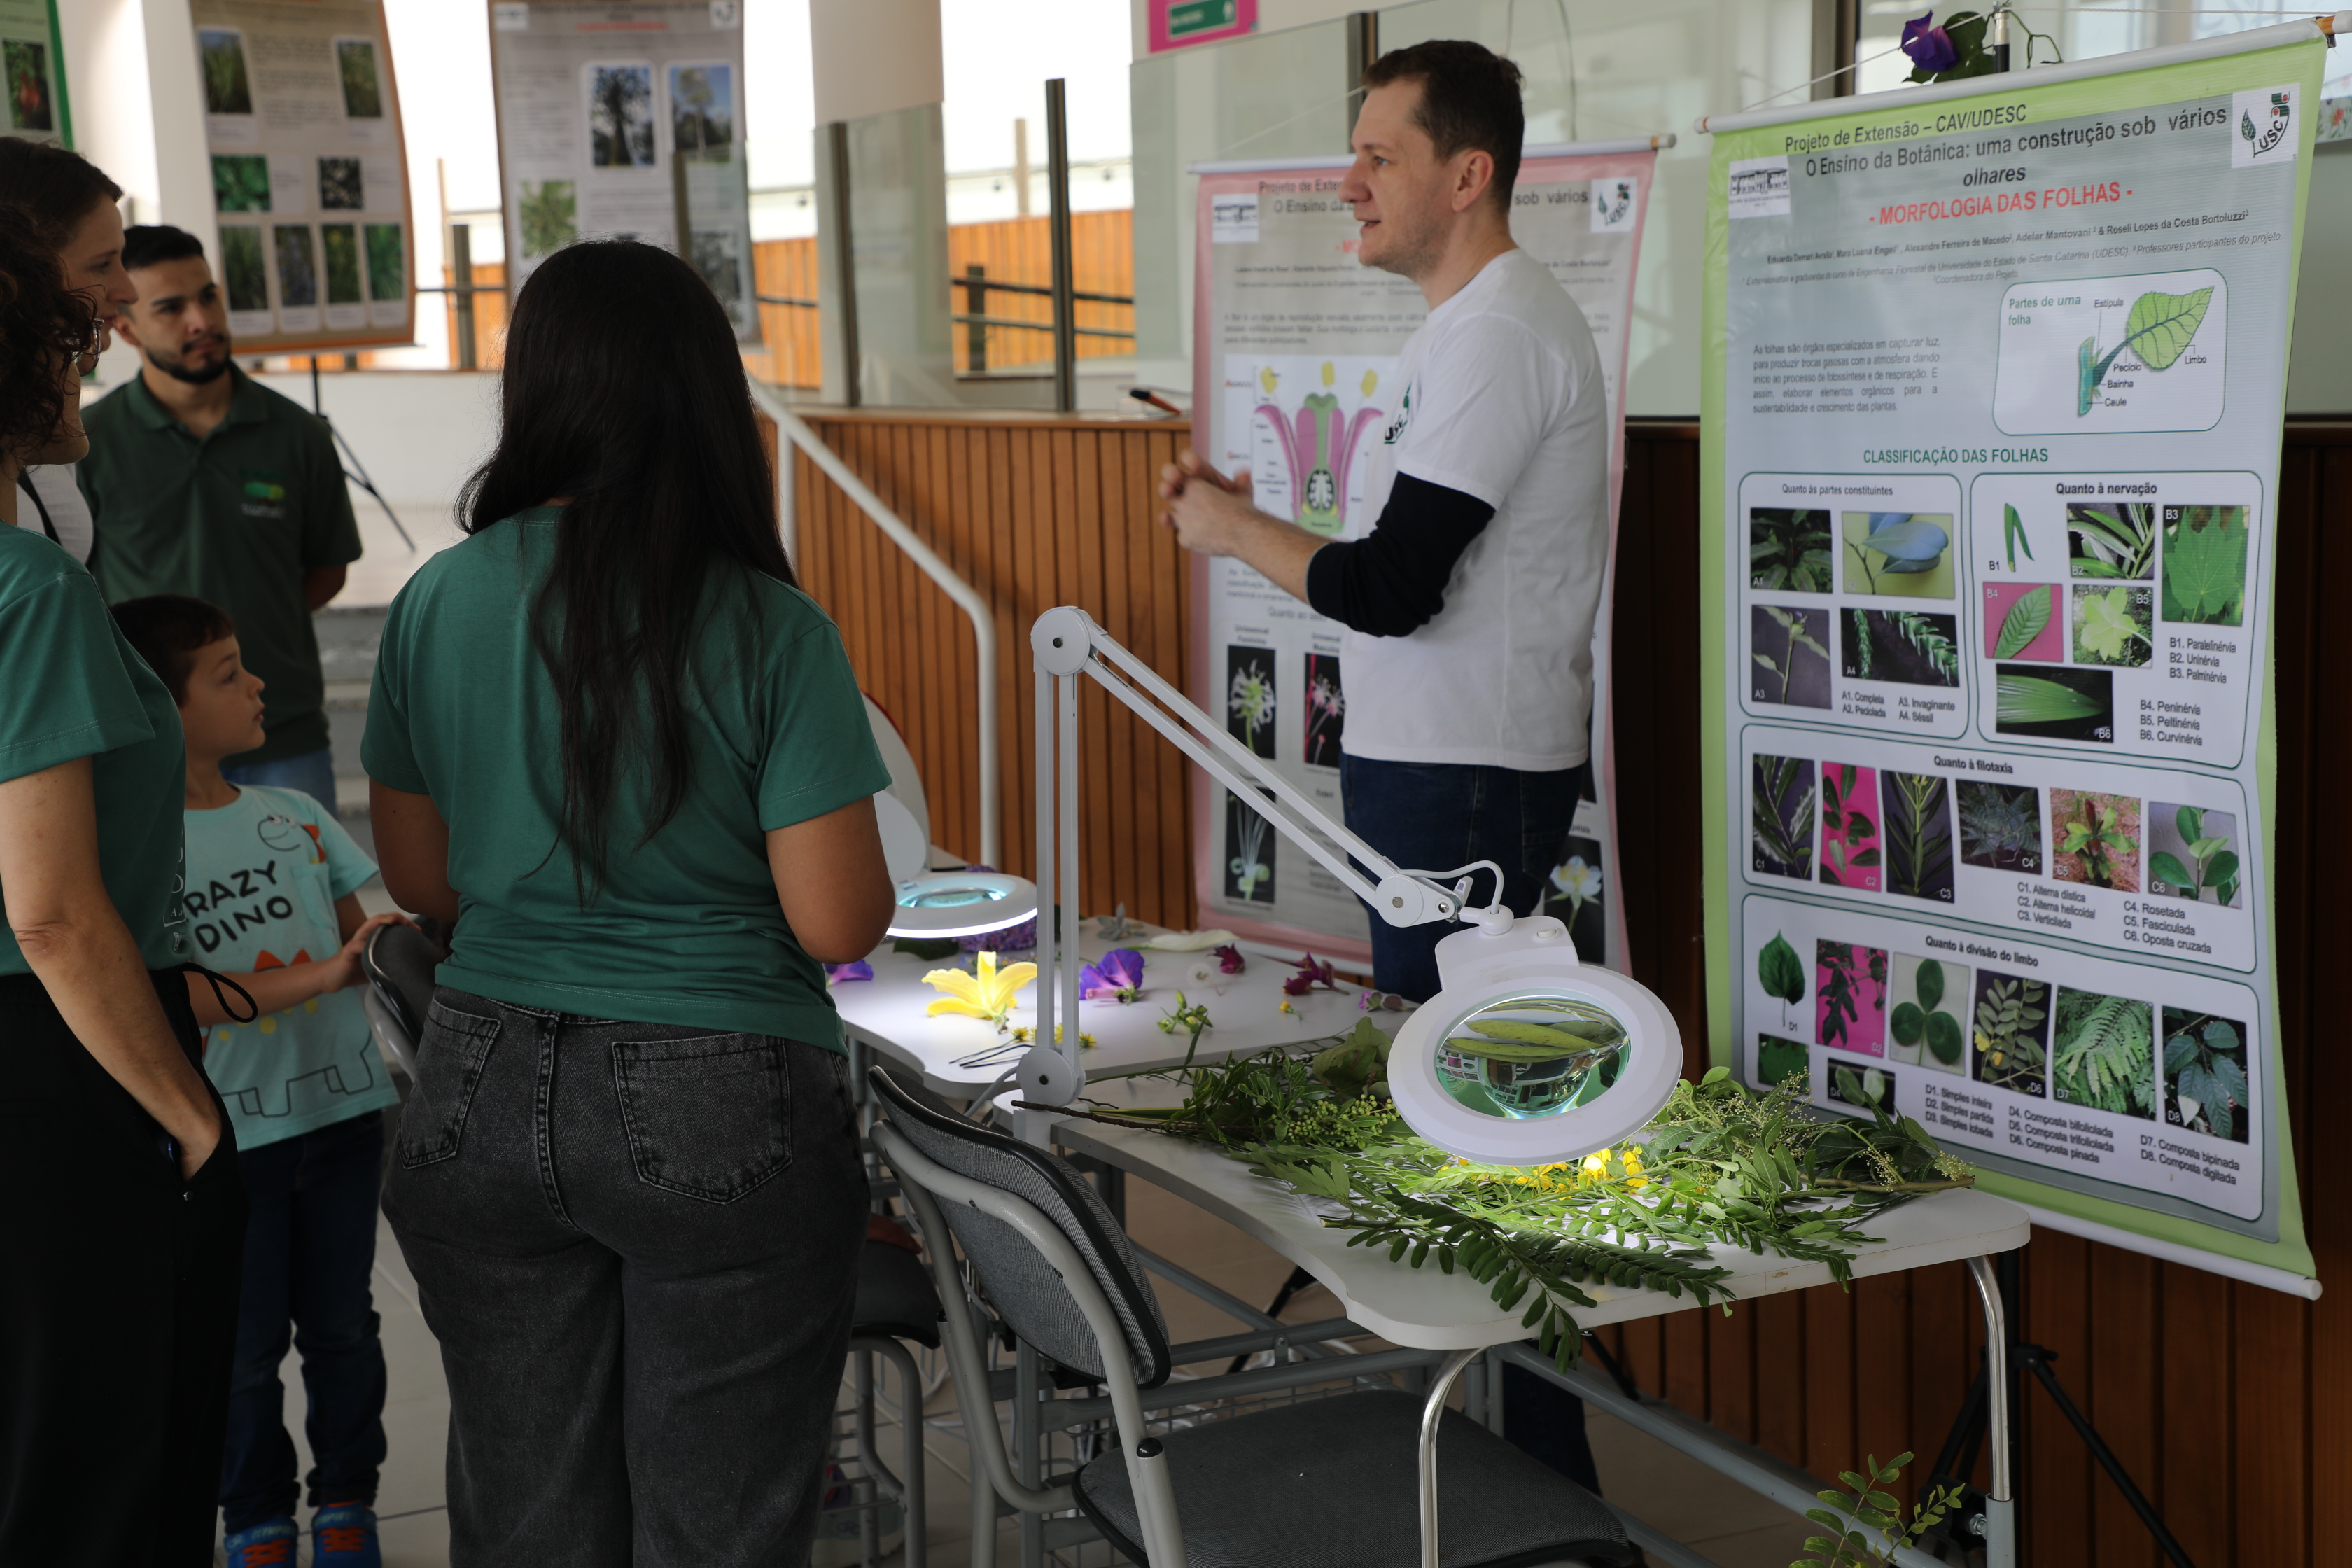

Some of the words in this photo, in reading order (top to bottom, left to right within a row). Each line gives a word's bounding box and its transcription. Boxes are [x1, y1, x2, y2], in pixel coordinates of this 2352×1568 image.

[1786, 132, 1829, 154] Projeto
[1834, 130, 1849, 146] de
[1855, 120, 1919, 144] Extensão
[1936, 104, 2027, 133] CAV/UDESC
[1806, 159, 1817, 176] O
[1820, 153, 1868, 175] Ensino
[1874, 150, 1892, 169] da
[1898, 143, 1970, 167] Botânica:
[1976, 139, 2012, 156] uma
[2018, 122, 2115, 151] construção
[2121, 115, 2156, 137] sob
[2169, 106, 2227, 132] vários
[1963, 164, 2026, 188] olhares
[1259, 180, 1296, 195] Projeto
[1298, 179, 1312, 192] de
[1515, 190, 1539, 206] sob
[1546, 188, 1589, 204] vários
[1880, 197, 1992, 225] MORFOLOGIA
[1997, 190, 2036, 214] DAS
[2043, 181, 2121, 209] FOLHAS
[1273, 199, 1284, 214] O
[1286, 198, 1327, 213] Ensino
[1904, 239, 1940, 253] Alexandre
[1941, 237, 1970, 248] Ferreira
[1972, 237, 1981, 246] de
[2016, 230, 2044, 242] Adelar
[2046, 227, 2092, 239] Mantovani
[2099, 226, 2105, 235] &
[2107, 223, 2132, 235] Roseli
[2134, 220, 2159, 232] Lopes
[2161, 218, 2172, 230] da
[2174, 216, 2200, 228] Costa
[2029, 252, 2052, 263] Santa
[2055, 250, 2090, 262] Catarina
[2185, 237, 2237, 252] participantes
[2239, 234, 2250, 244] do
[2009, 298, 2038, 309] Partes
[2042, 296, 2054, 307] de
[2058, 296, 2082, 306] uma
[2094, 298, 2124, 309] Estípula
[2008, 314, 2031, 326] folha
[2185, 355, 2207, 365] Limbo
[2107, 379, 2134, 388] Bainha
[2105, 398, 2127, 407] Caule
[1863, 447, 1958, 466] CLASSIFICAÇÃO
[1962, 449, 1987, 463] DAS
[1992, 448, 2048, 463] FOLHAS
[1782, 484, 1807, 495] Quanto
[1809, 484, 1817, 494] às
[1819, 485, 1842, 496] partes
[1844, 484, 1893, 496] constituintes
[2056, 483, 2094, 495] Quanto
[2098, 482, 2104, 494] à
[2107, 483, 2157, 496] nervação
[2166, 509, 2178, 520] B3
[1989, 561, 2000, 571] B1
[2072, 565, 2084, 576] B2
[1987, 589, 1998, 598] B4
[2136, 594, 2149, 604] B5
[2170, 637, 2184, 648] B1.
[2188, 638, 2236, 653] Paralelinérvia
[2170, 652, 2184, 664] B2.
[2188, 654, 2220, 667] Uninérvia
[2170, 668, 2184, 679] B3.
[2187, 668, 2226, 684] Palminérvia
[1755, 689, 1765, 699] A3
[1842, 691, 1854, 701] A1.
[1855, 692, 1884, 705] Completa
[1843, 704, 1854, 715] A2.
[1898, 696, 1910, 707] A3.
[1912, 698, 1955, 712] Invaginante
[2141, 699, 2155, 710] B4.
[2157, 701, 2201, 715] Peninérvia
[1899, 710, 1910, 721] A4.
[1912, 710, 1933, 723] Séssil
[2141, 715, 2155, 726] B5.
[2157, 716, 2199, 731] Peltinérvia
[2099, 728, 2111, 739] B6
[2140, 729, 2154, 741] B6.
[2157, 731, 2202, 746] Curvinérvia
[1934, 755, 1966, 769] Quanto
[1968, 757, 1975, 769] à
[1977, 759, 2013, 774] filotaxia
[2022, 858, 2033, 868] C4
[2057, 864, 2068, 876] C5
[1865, 876, 1877, 887] C2
[2152, 881, 2166, 893] C6
[183, 860, 278, 921] RAZY
[1940, 888, 1952, 899] C3
[2017, 882, 2031, 894] C1.
[2033, 884, 2059, 898] Alterna
[2061, 889, 2086, 902] dística
[2017, 897, 2031, 909] C2.
[2033, 899, 2059, 913] Alterna
[2061, 904, 2095, 919] helicoidal
[2124, 901, 2139, 913] C4.
[2142, 904, 2185, 919] Rosetada
[195, 895, 293, 953] DINO
[2017, 910, 2031, 922] C3.
[2033, 912, 2072, 929] Verticilada
[2124, 916, 2139, 927] C5.
[2142, 918, 2195, 936] Fasciculada
[2124, 930, 2139, 942] C6.
[2142, 932, 2175, 949] Oposta
[2177, 940, 2212, 954] cruzada
[1926, 936, 1956, 951] Quanto
[1959, 941, 1964, 953] à
[1966, 943, 1998, 959] divisão
[2000, 949, 2012, 961] do
[2013, 952, 2038, 967] limbo
[1789, 1021, 1798, 1032] D1
[1926, 1084, 1939, 1096] D1.
[1941, 1088, 1970, 1103] Simples
[1972, 1095, 1993, 1110] inteira
[2057, 1087, 2070, 1099] D7
[1926, 1098, 1939, 1110] D2.
[1941, 1101, 1968, 1116] Simples
[2009, 1106, 2022, 1118] D4.
[2024, 1110, 2067, 1128] Composta
[2069, 1119, 2113, 1138] bifoliolada
[2025, 1124, 2068, 1142] Composta
[2026, 1138, 2068, 1156] Composta
[2071, 1147, 2099, 1163] pinada
[2141, 1134, 2156, 1148] D7.
[2159, 1138, 2201, 1161] Composta
[2202, 1150, 2240, 1171] bipinada
[2141, 1148, 2157, 1162] D8.
[2159, 1152, 2201, 1175] Composta
[2203, 1165, 2236, 1185] digitada
